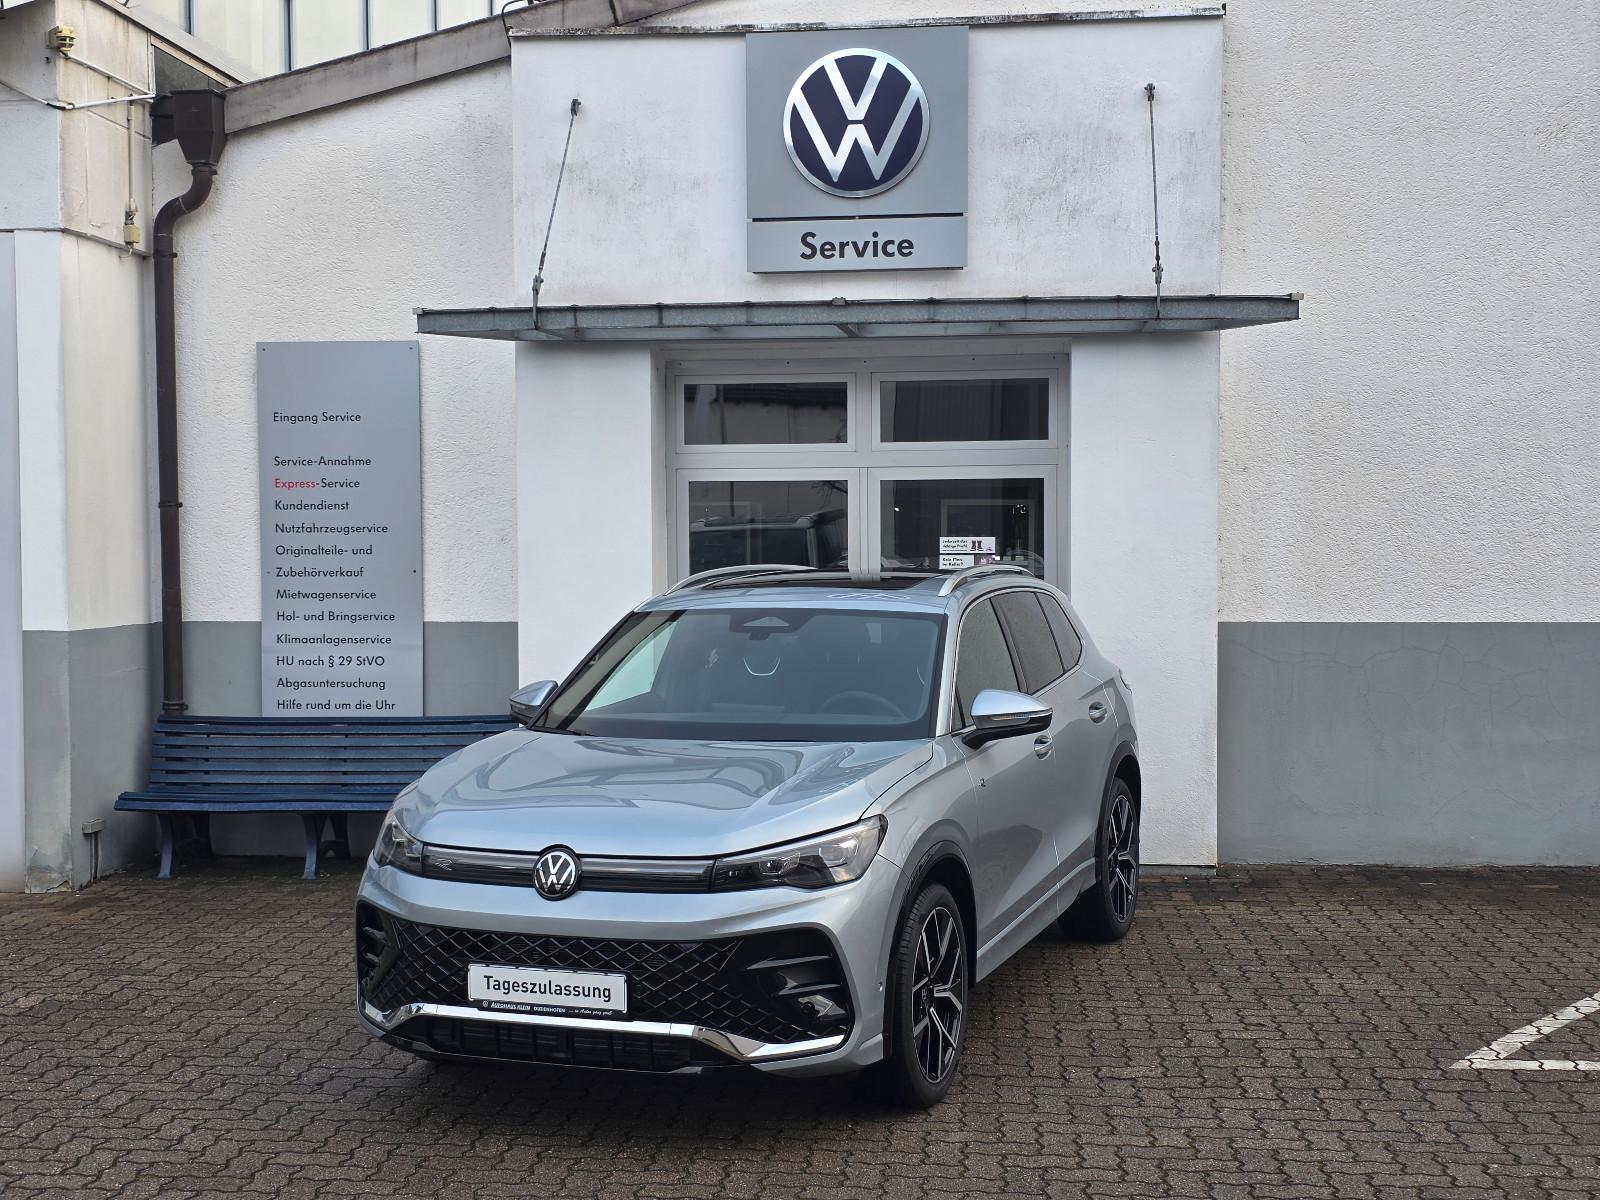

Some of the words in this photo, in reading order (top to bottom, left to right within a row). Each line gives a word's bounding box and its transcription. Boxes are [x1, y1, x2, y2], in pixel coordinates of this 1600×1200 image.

[800, 232, 914, 260] Service
[273, 412, 318, 424] Eingang
[322, 412, 362, 422] Service
[274, 456, 372, 466] Service-Annahme
[274, 478, 360, 490] Express-Service
[275, 500, 349, 510] Kundendienst
[275, 523, 388, 535] Nutzfahrzeugservice
[275, 545, 348, 557] Originalteile-
[352, 545, 373, 555] und
[276, 567, 364, 577] Zubehörverkauf
[276, 590, 377, 601] Mietwagenservice
[276, 611, 300, 621] Hol-
[304, 612, 324, 621] und
[328, 612, 396, 623] Bringservice
[276, 634, 392, 646] Klimaanlagenservice
[276, 656, 294, 666] HU
[298, 656, 324, 666] nach
[328, 655, 334, 667] §
[338, 656, 352, 666] 29
[356, 656, 385, 666] StVO
[276, 678, 386, 690] Abgasuntersuchung
[277, 700, 302, 710] Hilfe
[306, 700, 331, 710] rund
[335, 702, 351, 710] um
[355, 700, 372, 710] die
[376, 700, 396, 710] Uhr
[484, 975, 611, 1002] Tageszulassung
